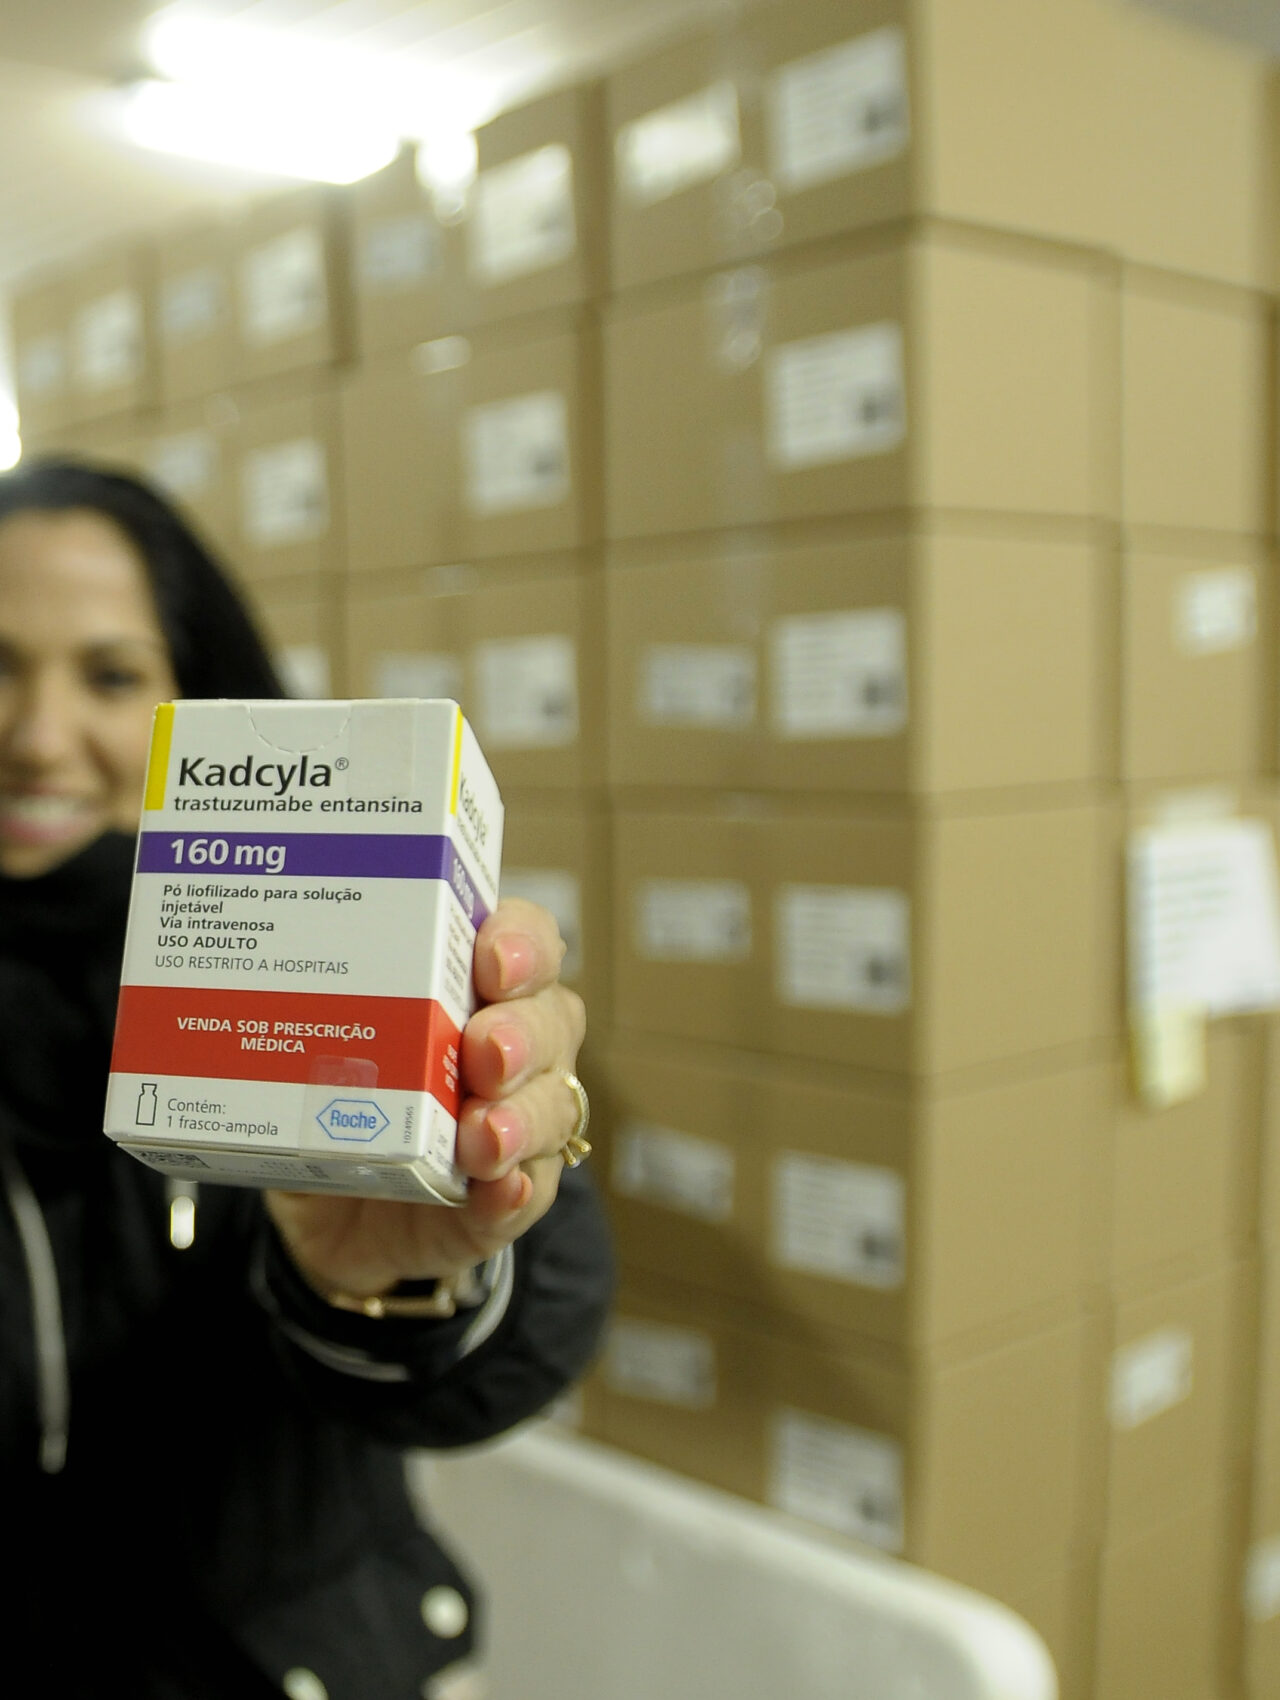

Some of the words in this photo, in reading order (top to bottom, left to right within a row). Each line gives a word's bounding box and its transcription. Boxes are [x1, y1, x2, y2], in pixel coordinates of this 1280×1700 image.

[179, 755, 349, 795] Kadcyla®
[175, 796, 313, 812] trastuzumabe
[320, 797, 423, 813] entansina
[171, 839, 228, 865] 160
[235, 844, 286, 873] mg
[164, 884, 181, 897] Pó
[187, 884, 259, 899] liofilizado
[264, 889, 299, 902] para
[303, 888, 362, 903] solução
[161, 900, 223, 915] injetável
[161, 917, 182, 929] Via
[187, 917, 274, 932] intravenosa
[158, 936, 188, 948] USO
[194, 937, 258, 950] ADULTO
[155, 956, 184, 968] USO
[189, 956, 254, 970] RESTRITO
[258, 958, 268, 970] A
[274, 959, 349, 974] HOSPITAIS
[177, 1017, 232, 1032] VENDA
[237, 1020, 268, 1034] SOB
[274, 1021, 376, 1040] PRESCRIÇÃO
[241, 1035, 305, 1053] MÉDICA
[168, 1098, 226, 1115] Contém:
[167, 1115, 173, 1128] 1
[179, 1116, 278, 1137] frasco-ampola
[330, 1110, 377, 1129] Roche
